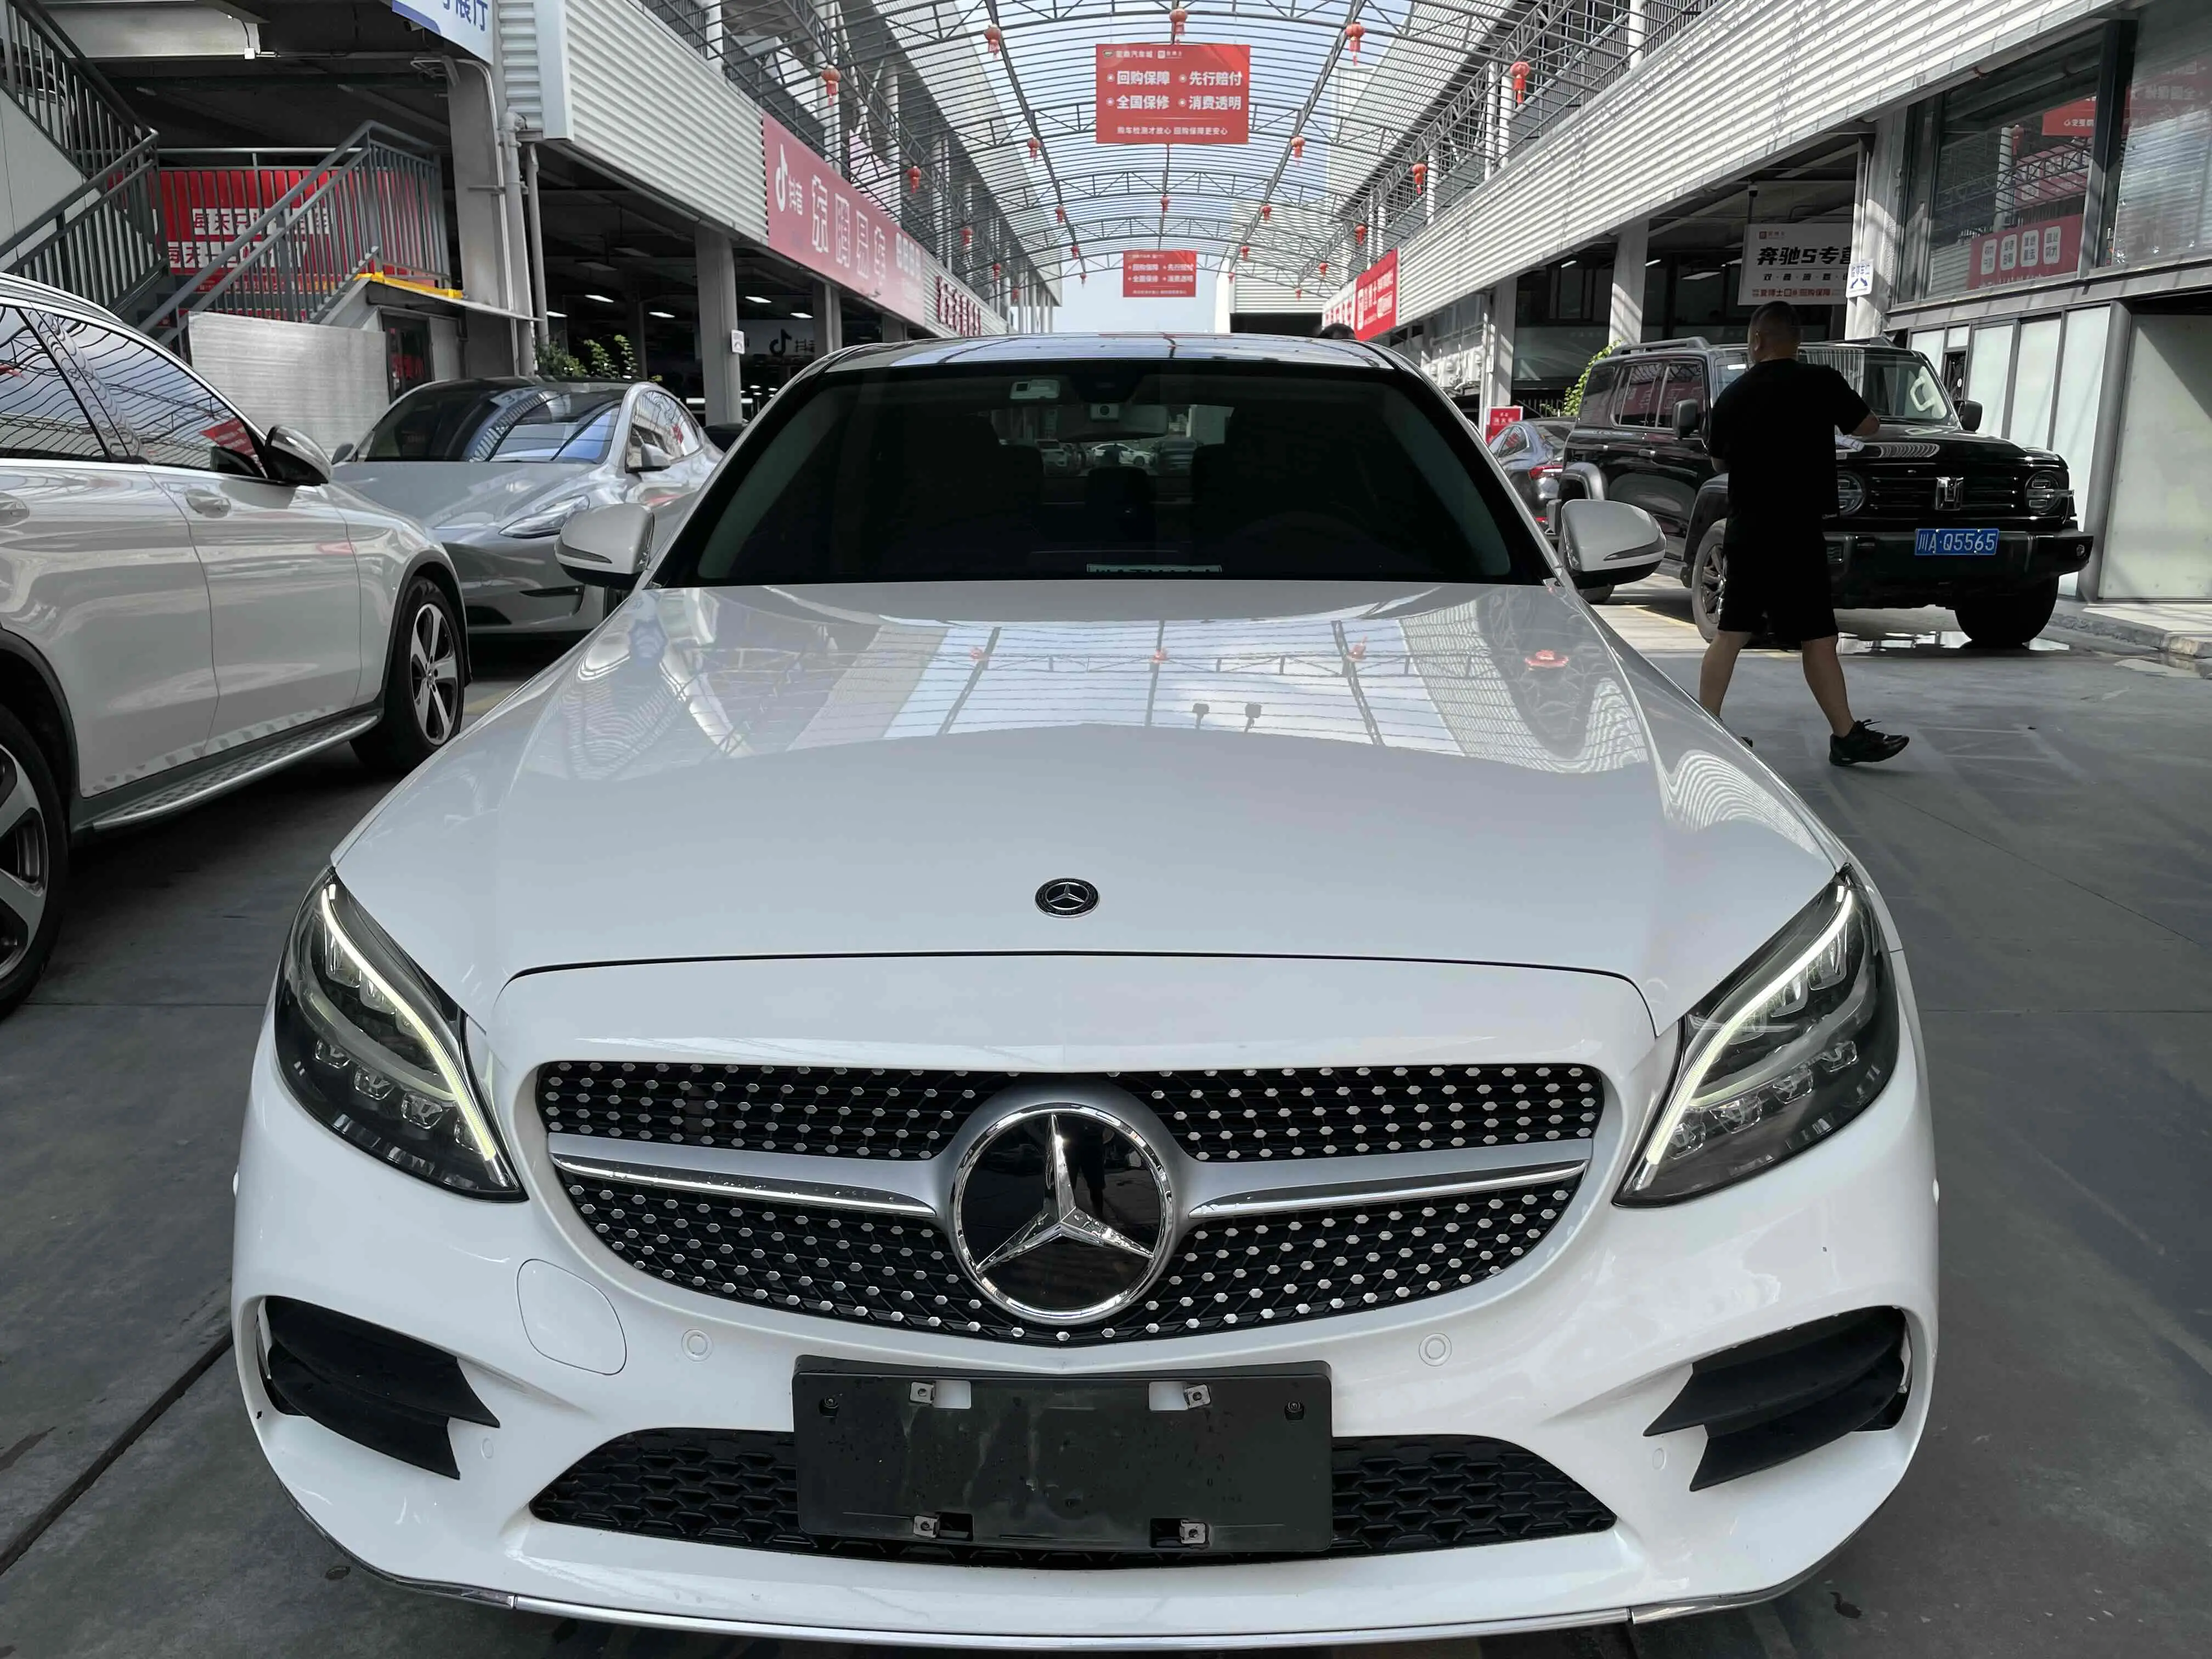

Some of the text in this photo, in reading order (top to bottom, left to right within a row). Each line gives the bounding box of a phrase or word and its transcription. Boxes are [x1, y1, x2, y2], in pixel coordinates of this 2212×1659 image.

[1116, 71, 1243, 86] 回购保障 先行赔付
[1116, 95, 1242, 110] 全国保修 消费透明
